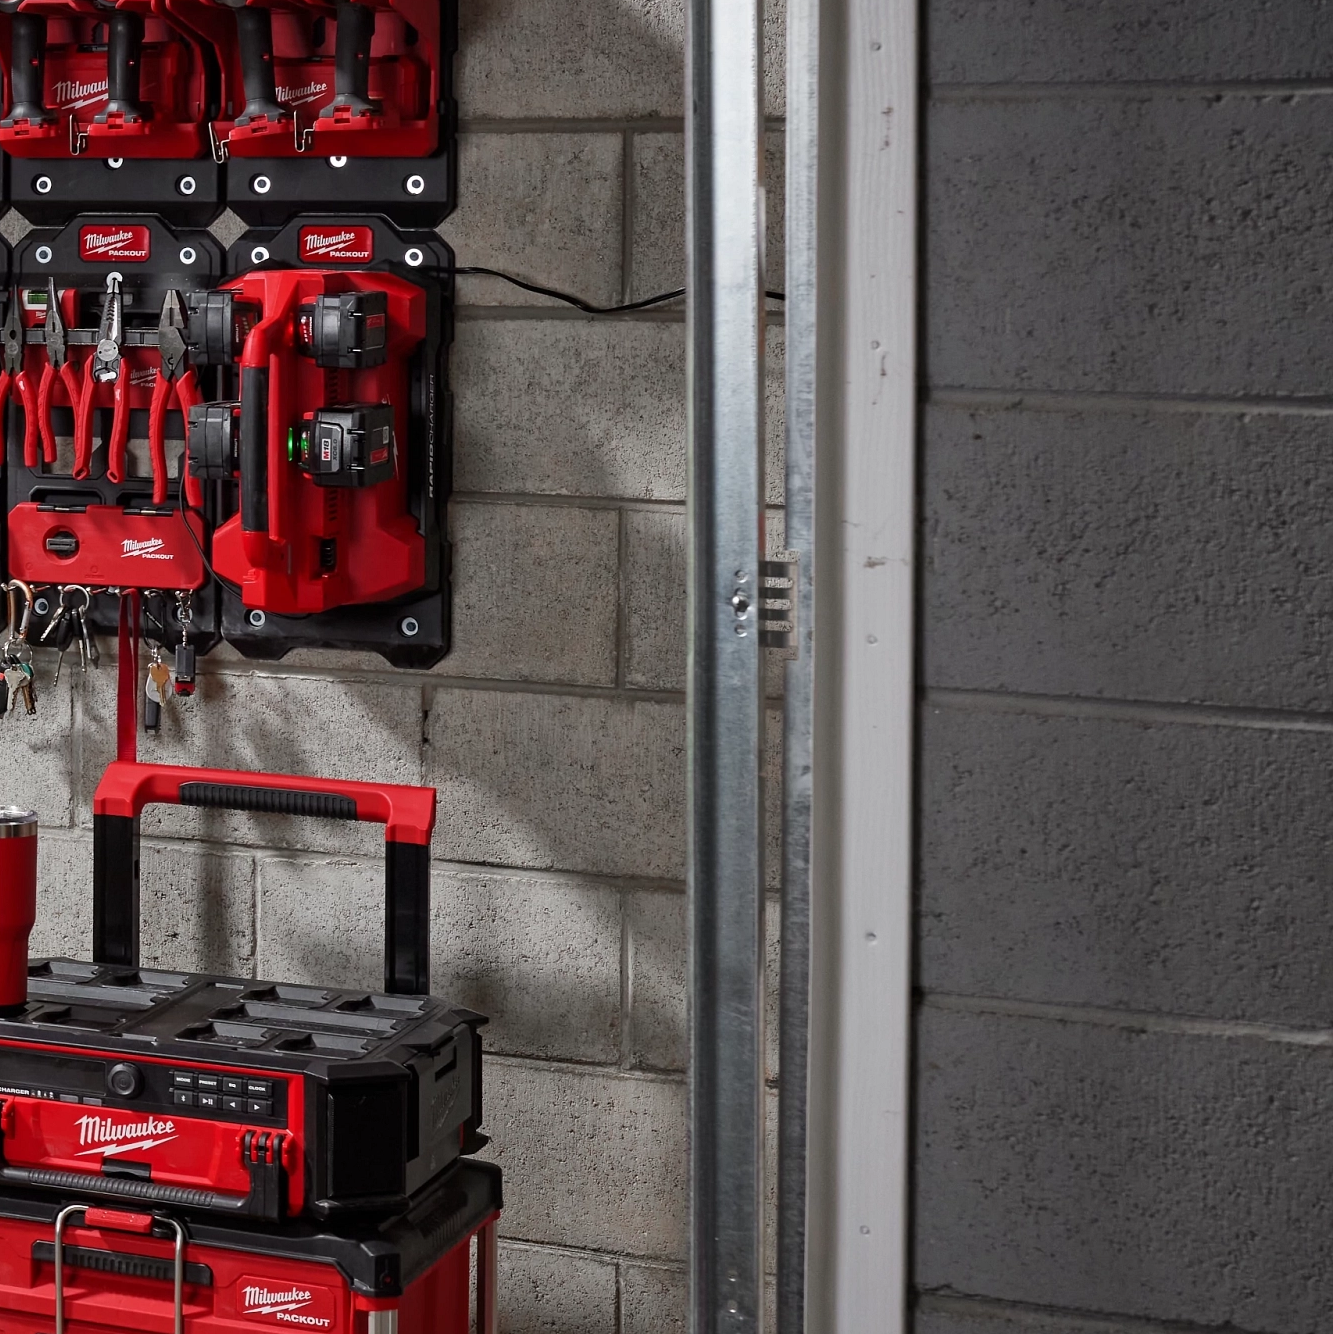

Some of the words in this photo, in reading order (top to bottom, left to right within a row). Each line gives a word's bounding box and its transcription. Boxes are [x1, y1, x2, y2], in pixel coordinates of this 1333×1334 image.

[52, 77, 108, 103] Milwau
[84, 230, 133, 251] Milwaukee
[304, 231, 355, 251] Milwaukee
[108, 249, 146, 257] PACKOUT
[329, 250, 369, 258] PACKOUT
[121, 538, 162, 556] Milwaukee
[75, 1115, 175, 1145] Milwaukee
[241, 1285, 311, 1309] Milwaukee
[276, 1312, 330, 1328] PACKOUT
